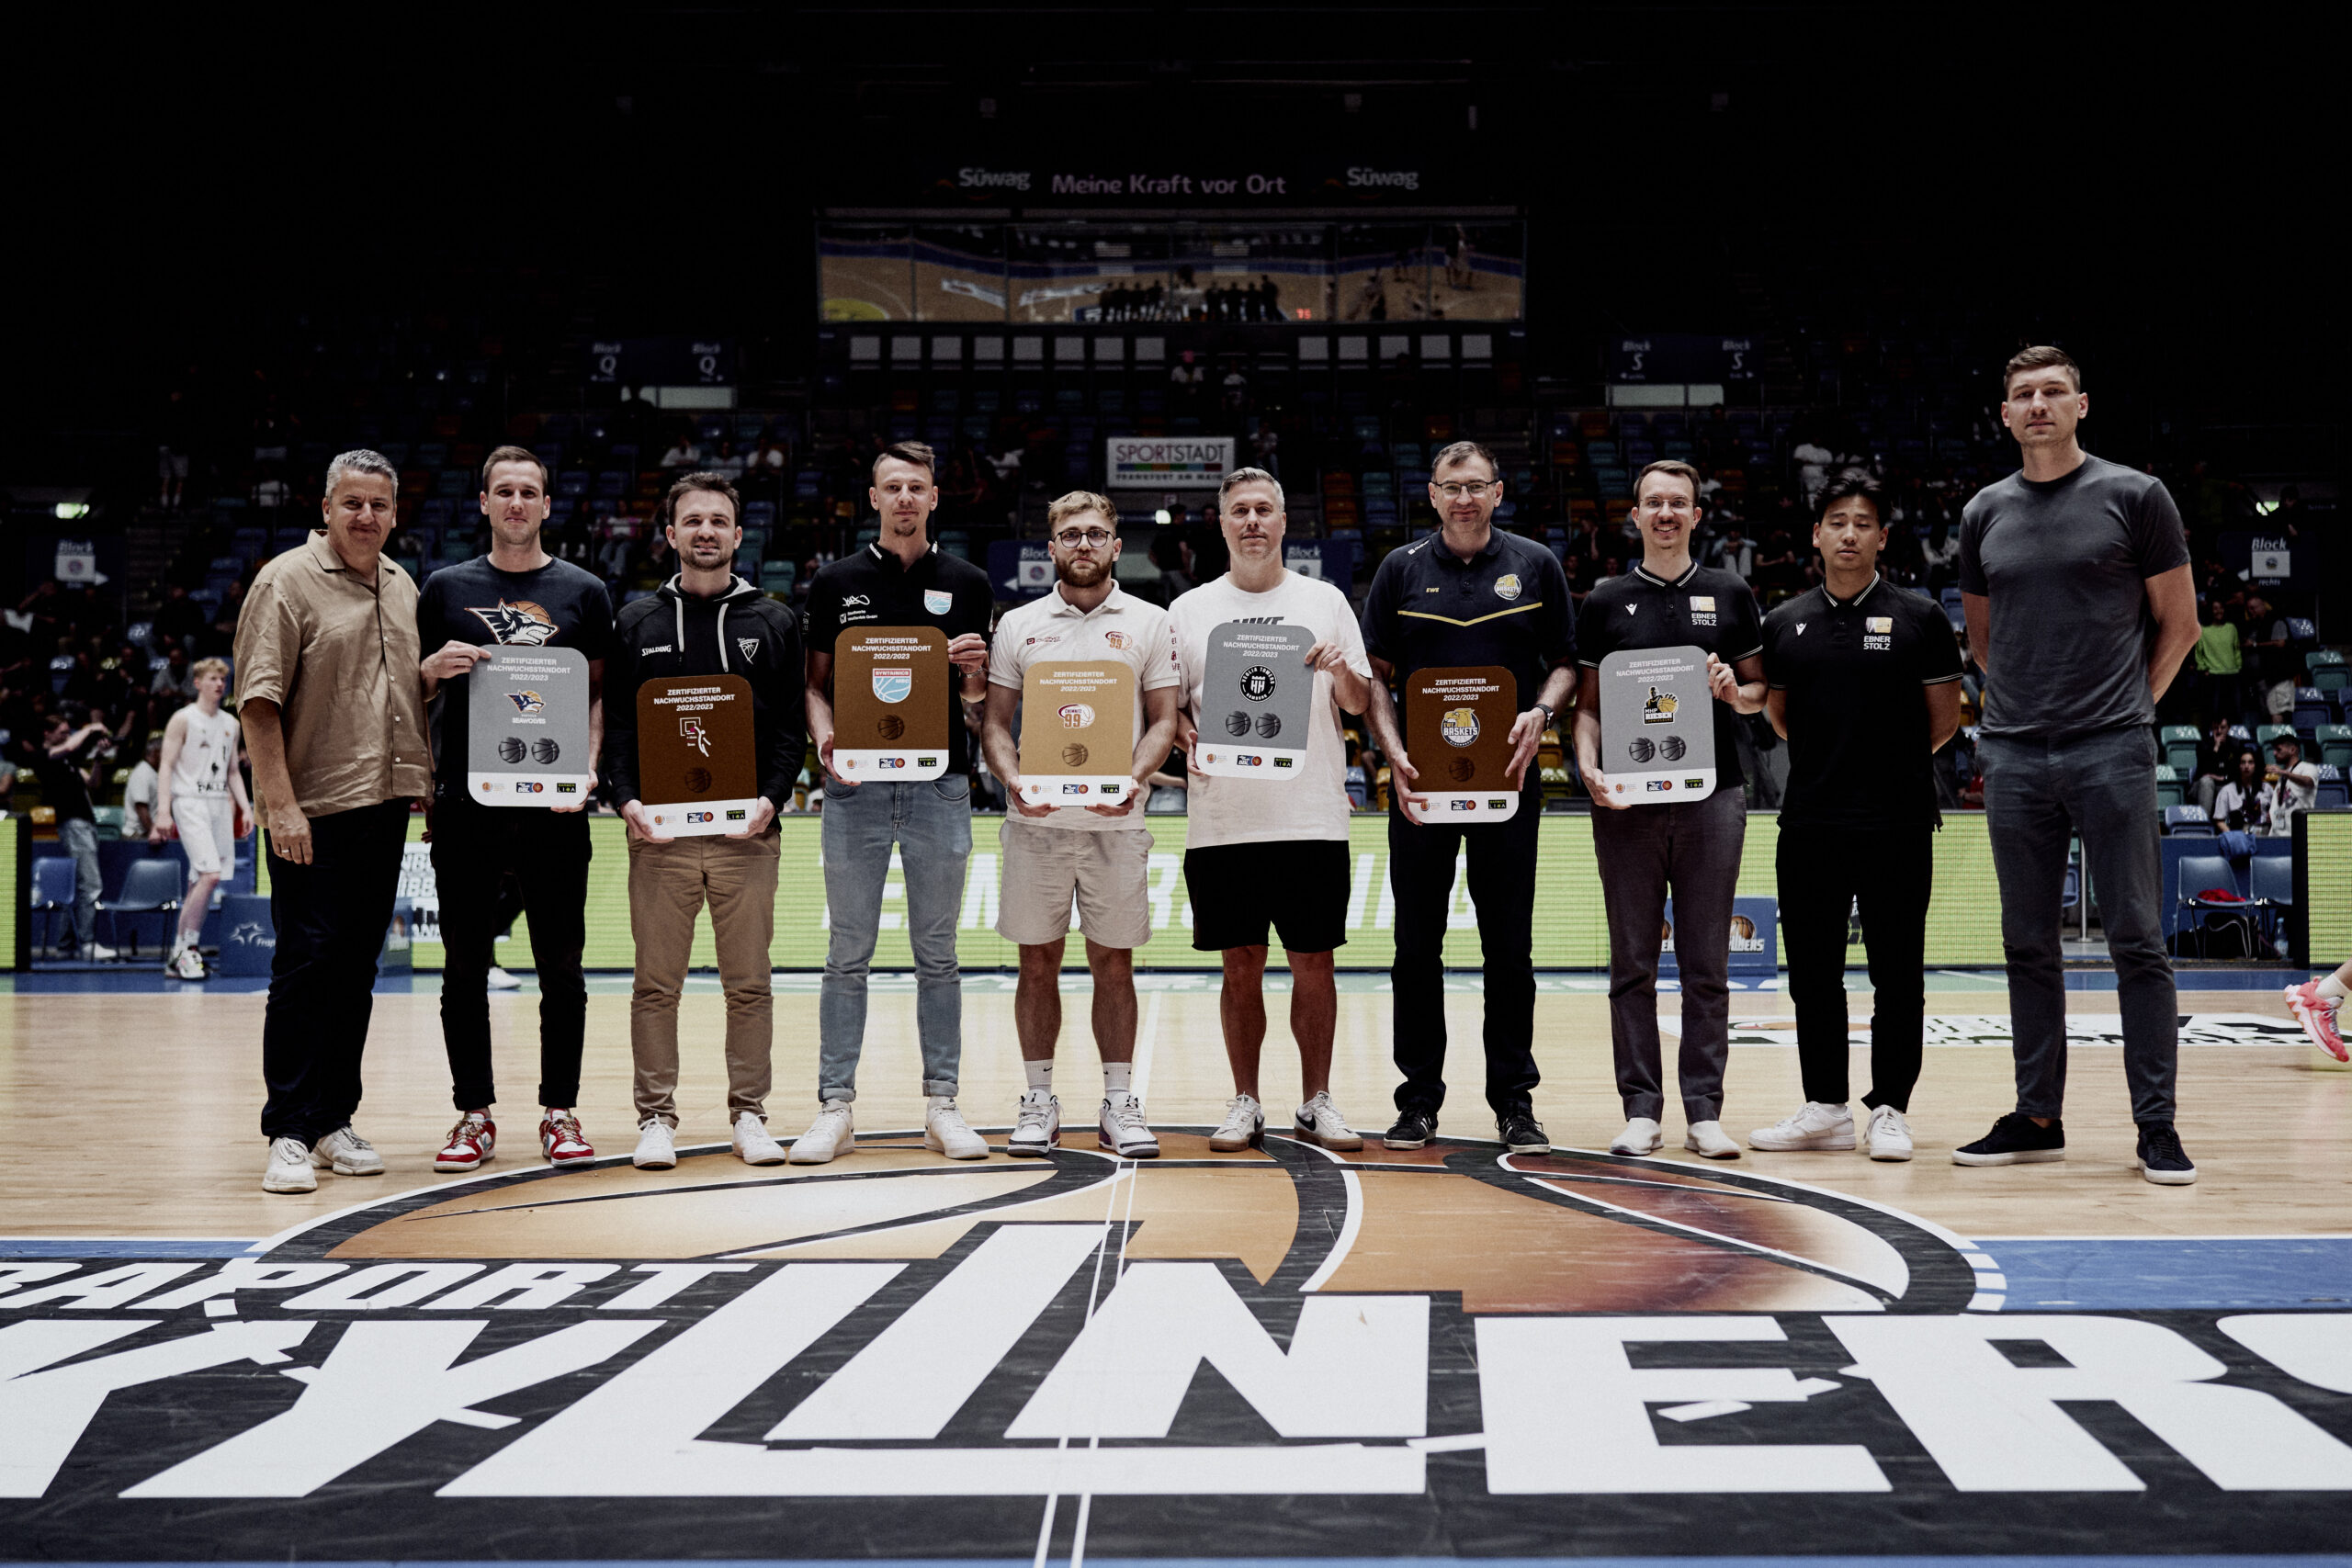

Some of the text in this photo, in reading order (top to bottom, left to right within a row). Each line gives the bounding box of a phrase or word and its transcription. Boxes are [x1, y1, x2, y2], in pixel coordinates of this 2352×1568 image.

[958, 167, 1031, 191] Süwag
[1347, 166, 1419, 190] Süwag
[1051, 174, 1286, 195] Meine Kraft vor Ort
[593, 344, 622, 354] Block
[692, 344, 720, 354] Block
[1623, 341, 1651, 351] Block
[1723, 341, 1750, 351] Block
[599, 355, 616, 376] Q
[698, 355, 716, 376] Q
[1632, 353, 1644, 370] S
[1731, 352, 1743, 370] S
[1115, 445, 1227, 462] SPORTSTADT
[2251, 536, 2287, 551] Block
[1286, 544, 1321, 558] Block
[1237, 634, 1287, 643] ZERTIFIZIERTER
[642, 644, 672, 656] SPALDING
[1223, 641, 1299, 651] NACHWUCHSSTANDORT
[1243, 650, 1278, 659] 2022/2023
[502, 657, 557, 666] ZERTIFIZIERTER
[1629, 658, 1681, 669] ZERTIFIZIERTER
[487, 665, 571, 674] NACHWUCHSSTANDORT
[1616, 665, 1694, 677] NACHWUCHSSTANDORT
[510, 673, 548, 682] 2022/2023
[1435, 678, 1487, 686] ZERTIFIZIERTER
[1637, 674, 1674, 683] 2022/2023
[667, 686, 721, 696] ZERTIFIZIERTER
[1422, 685, 1499, 694] NACHWUCHSSTANDORT
[654, 694, 735, 705] NACHWUCHSSTANDORT
[1442, 694, 1479, 702] 2022/2023
[676, 703, 714, 712] 2022/2023
[1064, 714, 1081, 728] 99
[1443, 727, 1478, 736] BASKETS
